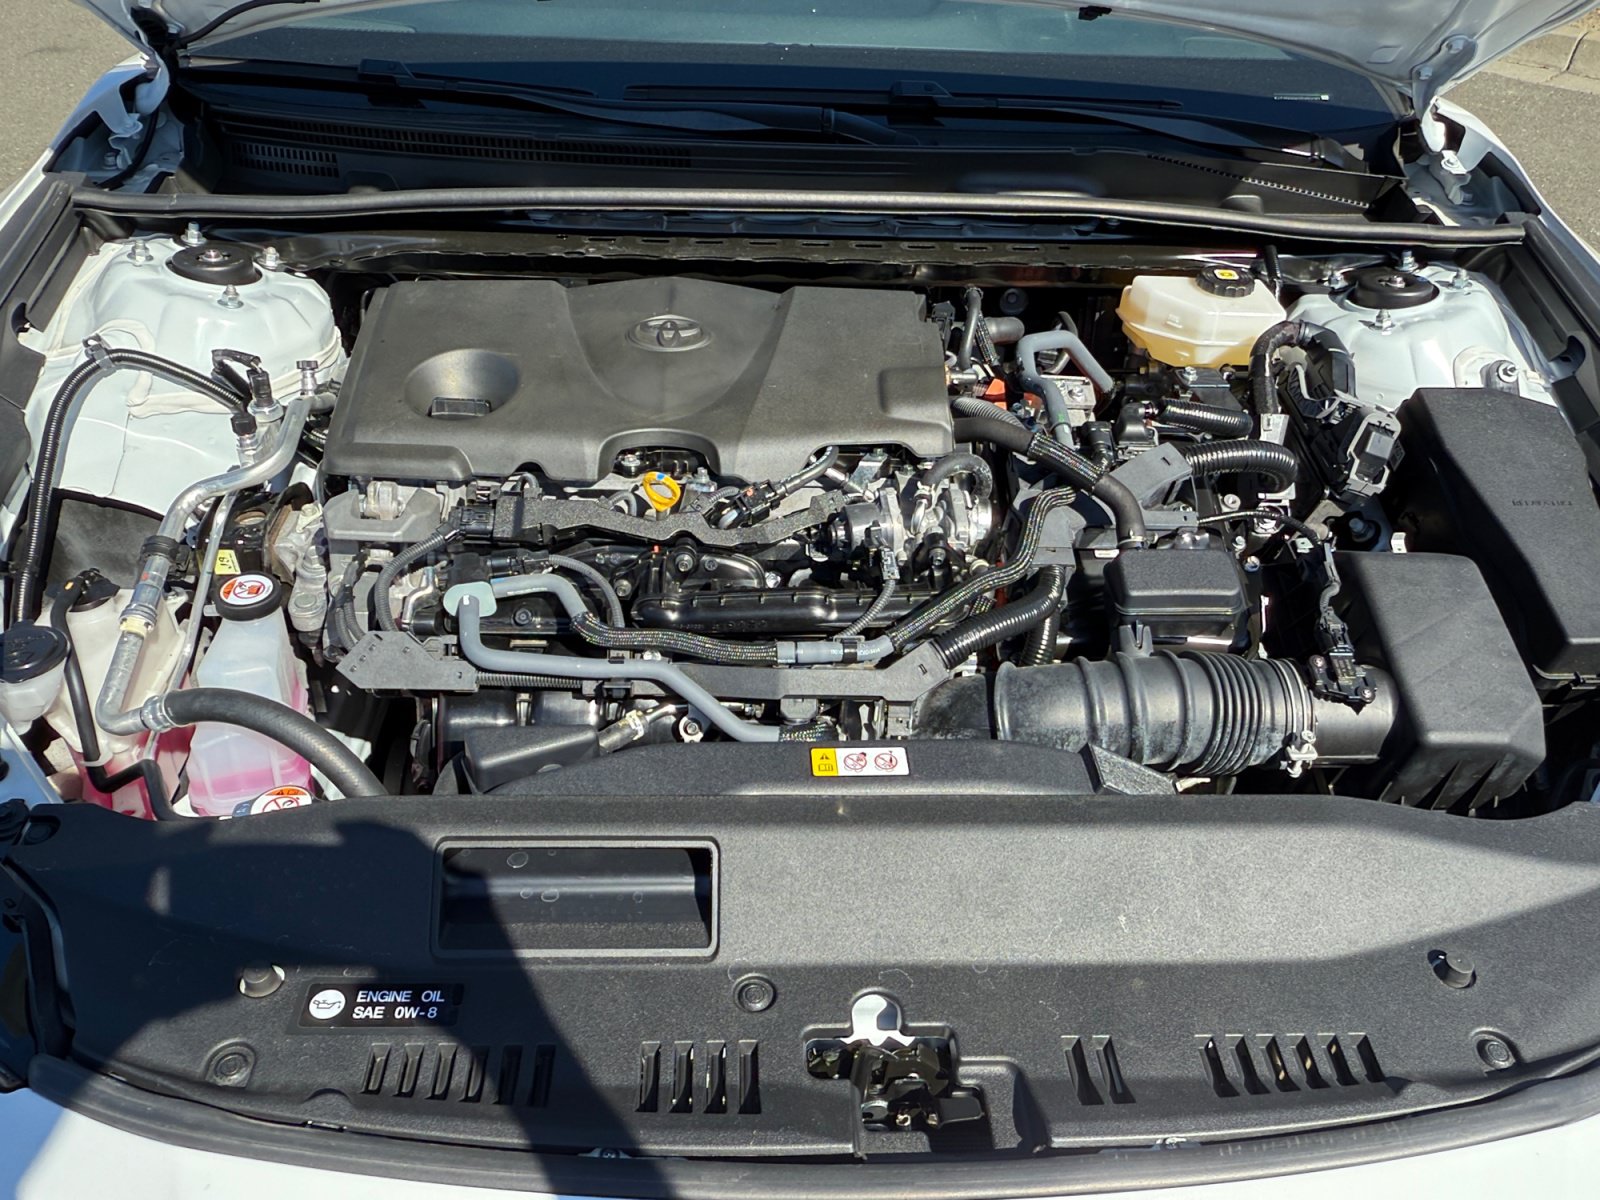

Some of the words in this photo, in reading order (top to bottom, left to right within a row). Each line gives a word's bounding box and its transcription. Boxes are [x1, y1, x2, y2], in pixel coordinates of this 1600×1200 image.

[356, 990, 412, 1003] ENGINE
[421, 990, 445, 1003] OIL
[352, 1006, 385, 1019] SAE
[394, 1006, 438, 1019] 0W-8
